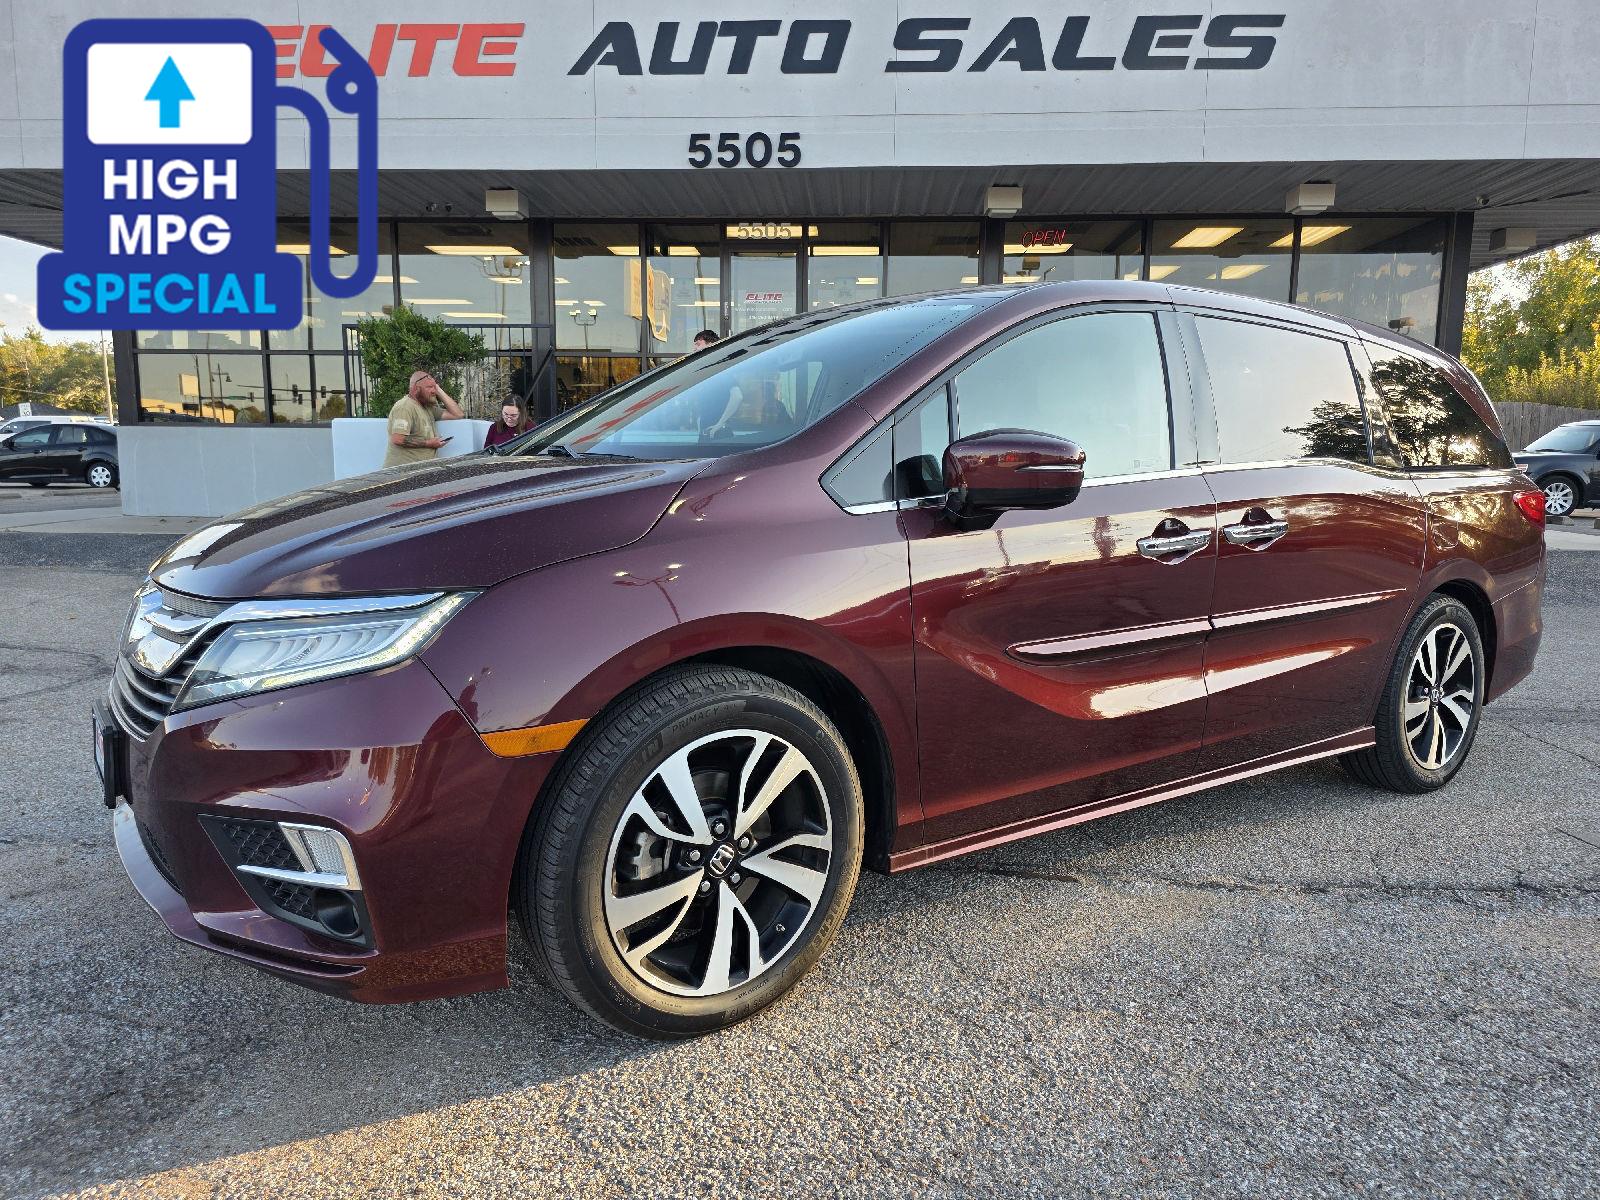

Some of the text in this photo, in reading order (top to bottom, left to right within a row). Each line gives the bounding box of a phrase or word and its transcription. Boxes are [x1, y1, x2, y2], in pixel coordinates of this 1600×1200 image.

[568, 19, 852, 76] AUTO
[884, 14, 1287, 73] SALES
[688, 131, 802, 169] 5505
[737, 222, 792, 240] 5505
[1022, 229, 1066, 248] OPEN
[745, 293, 783, 301] ELITE
